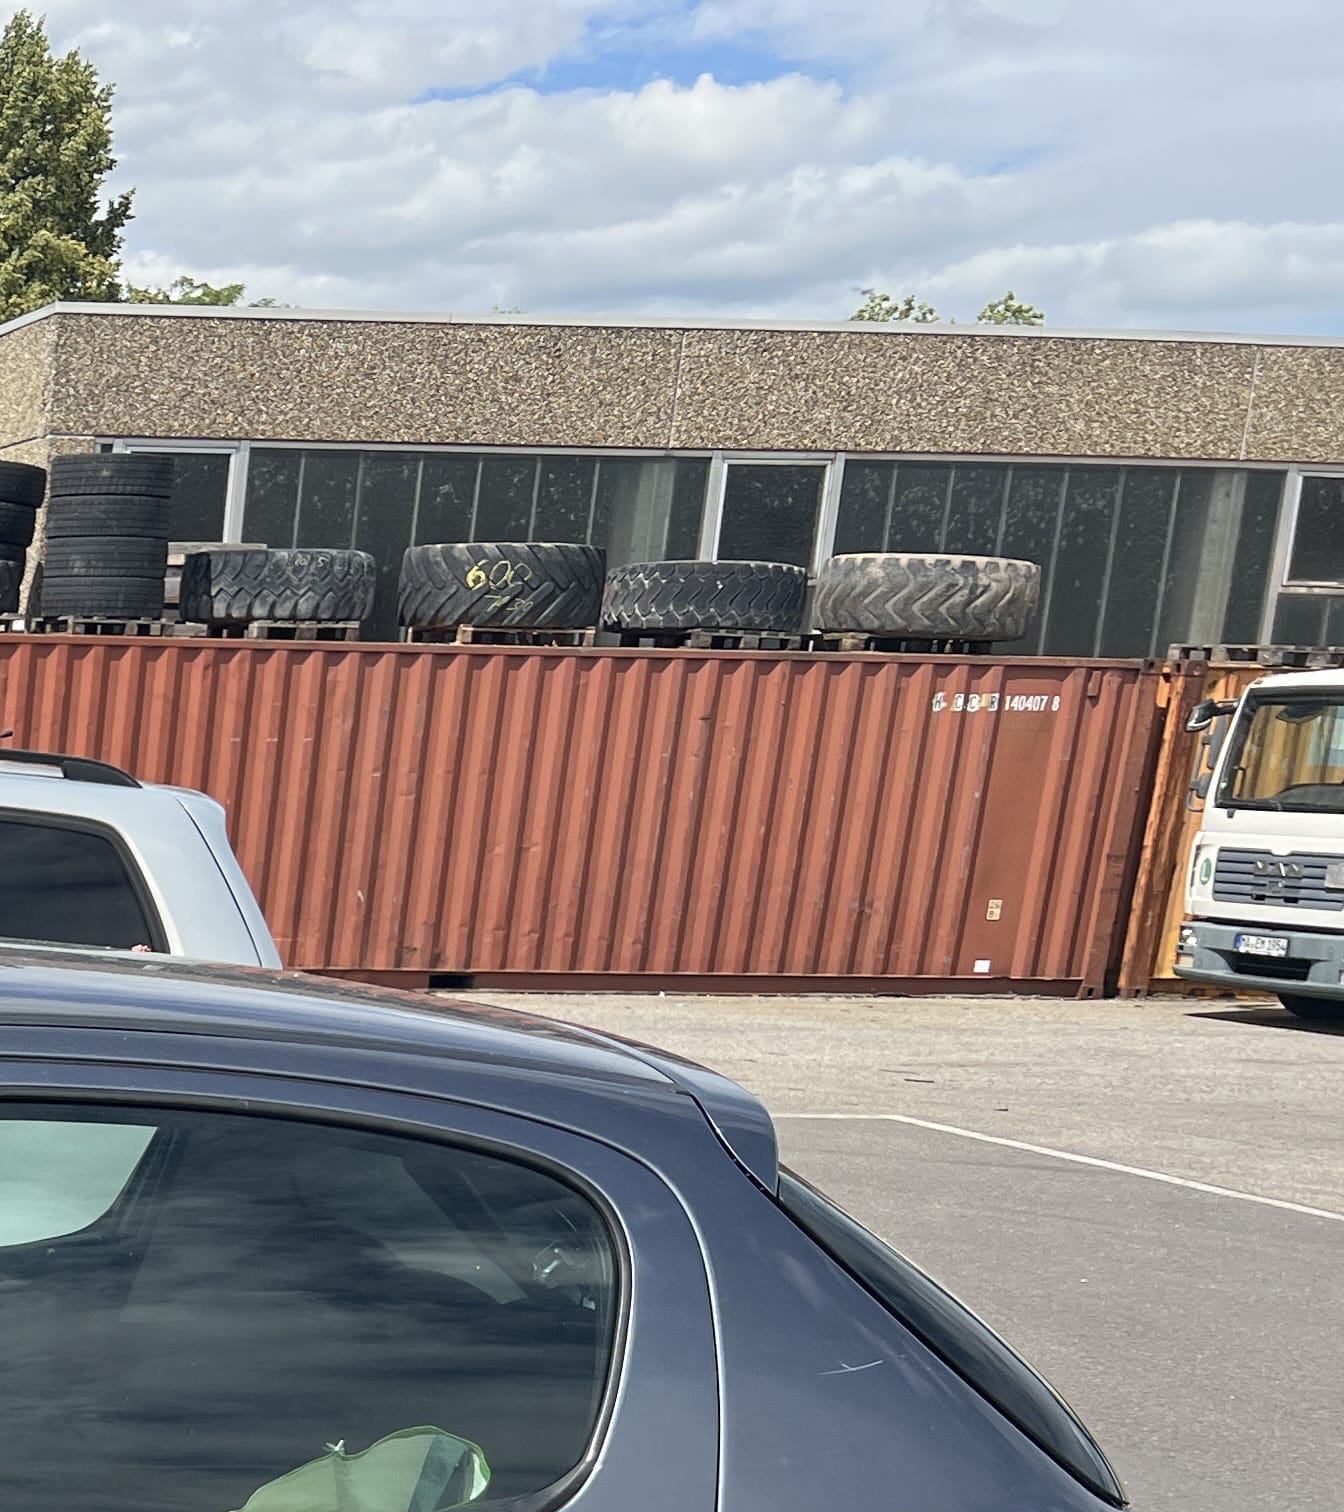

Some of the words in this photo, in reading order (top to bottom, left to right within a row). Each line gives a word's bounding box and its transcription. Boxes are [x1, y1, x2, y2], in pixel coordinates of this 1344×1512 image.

[466, 559, 532, 590] 600
[1005, 695, 1048, 711] 140407
[1052, 695, 1060, 711] 8
